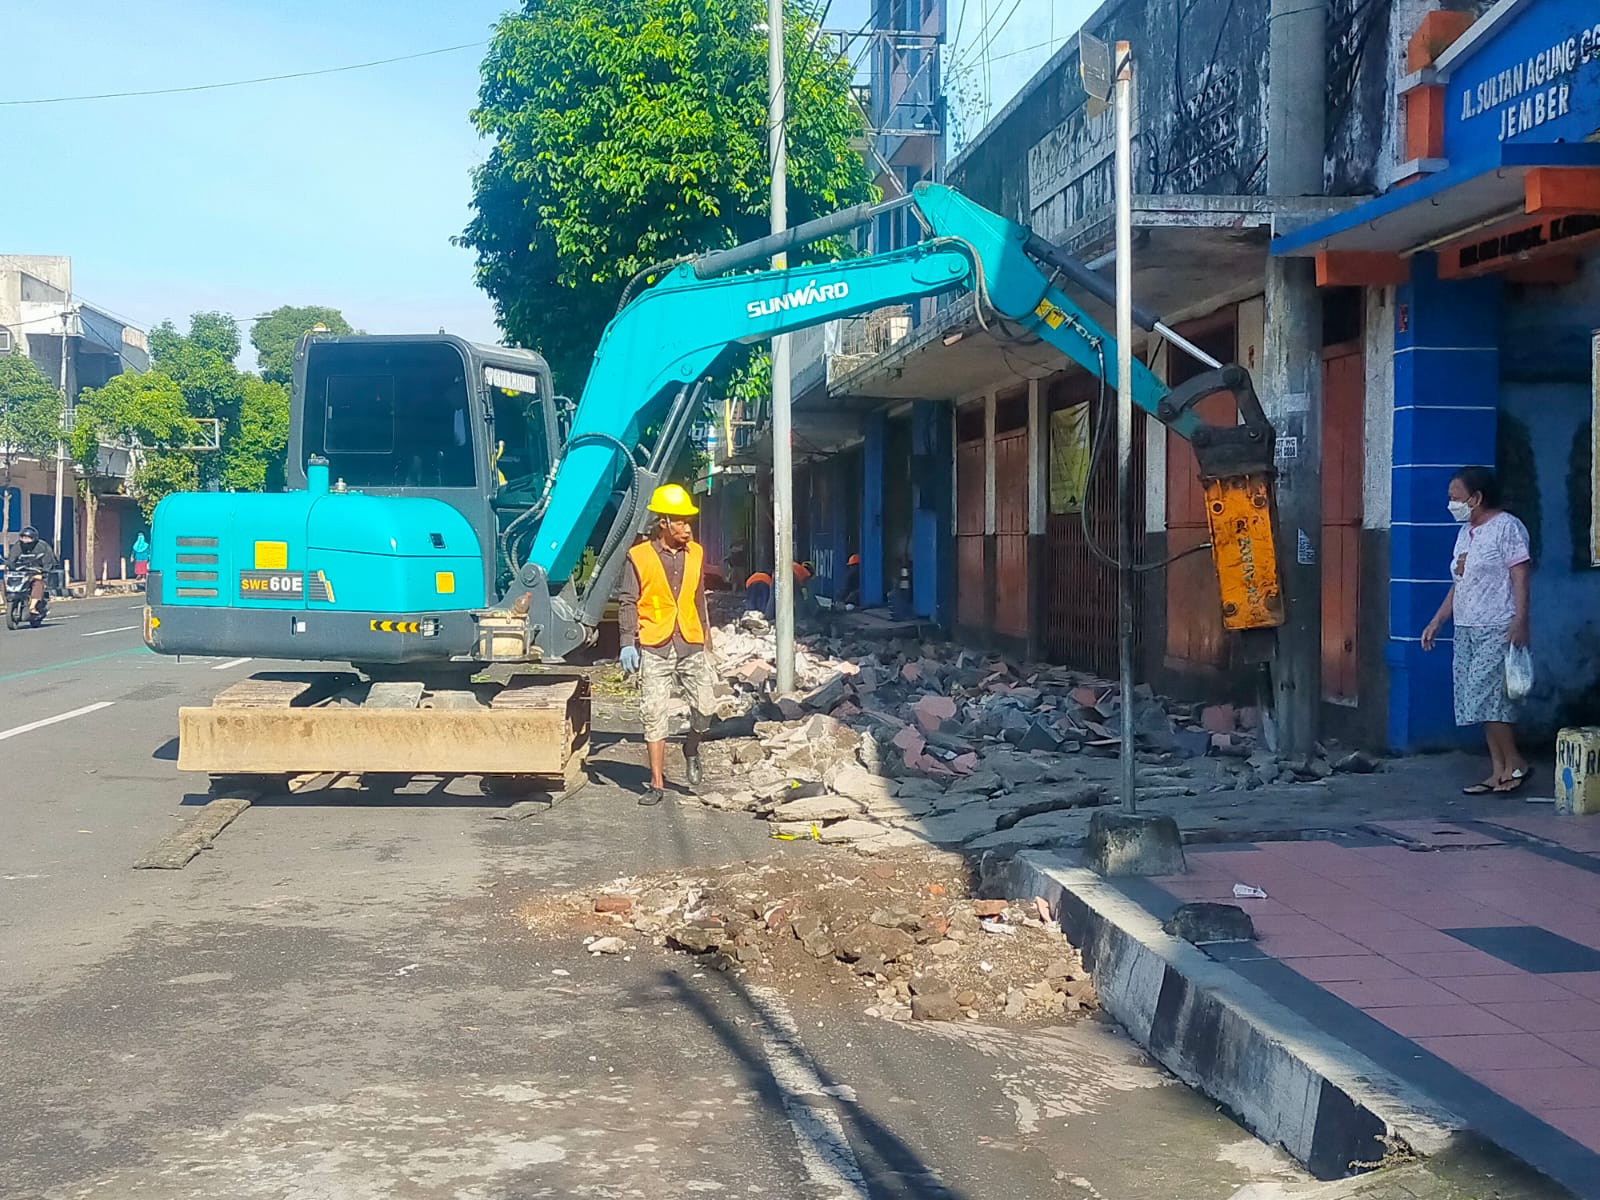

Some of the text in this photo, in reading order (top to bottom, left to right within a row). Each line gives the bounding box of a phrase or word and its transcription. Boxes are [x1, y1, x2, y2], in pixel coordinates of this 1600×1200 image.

[1477, 62, 1524, 114] SULTAN
[1526, 37, 1576, 91] AGUNG
[1498, 83, 1569, 142] JEMBER
[747, 280, 849, 318] SUNWARD
